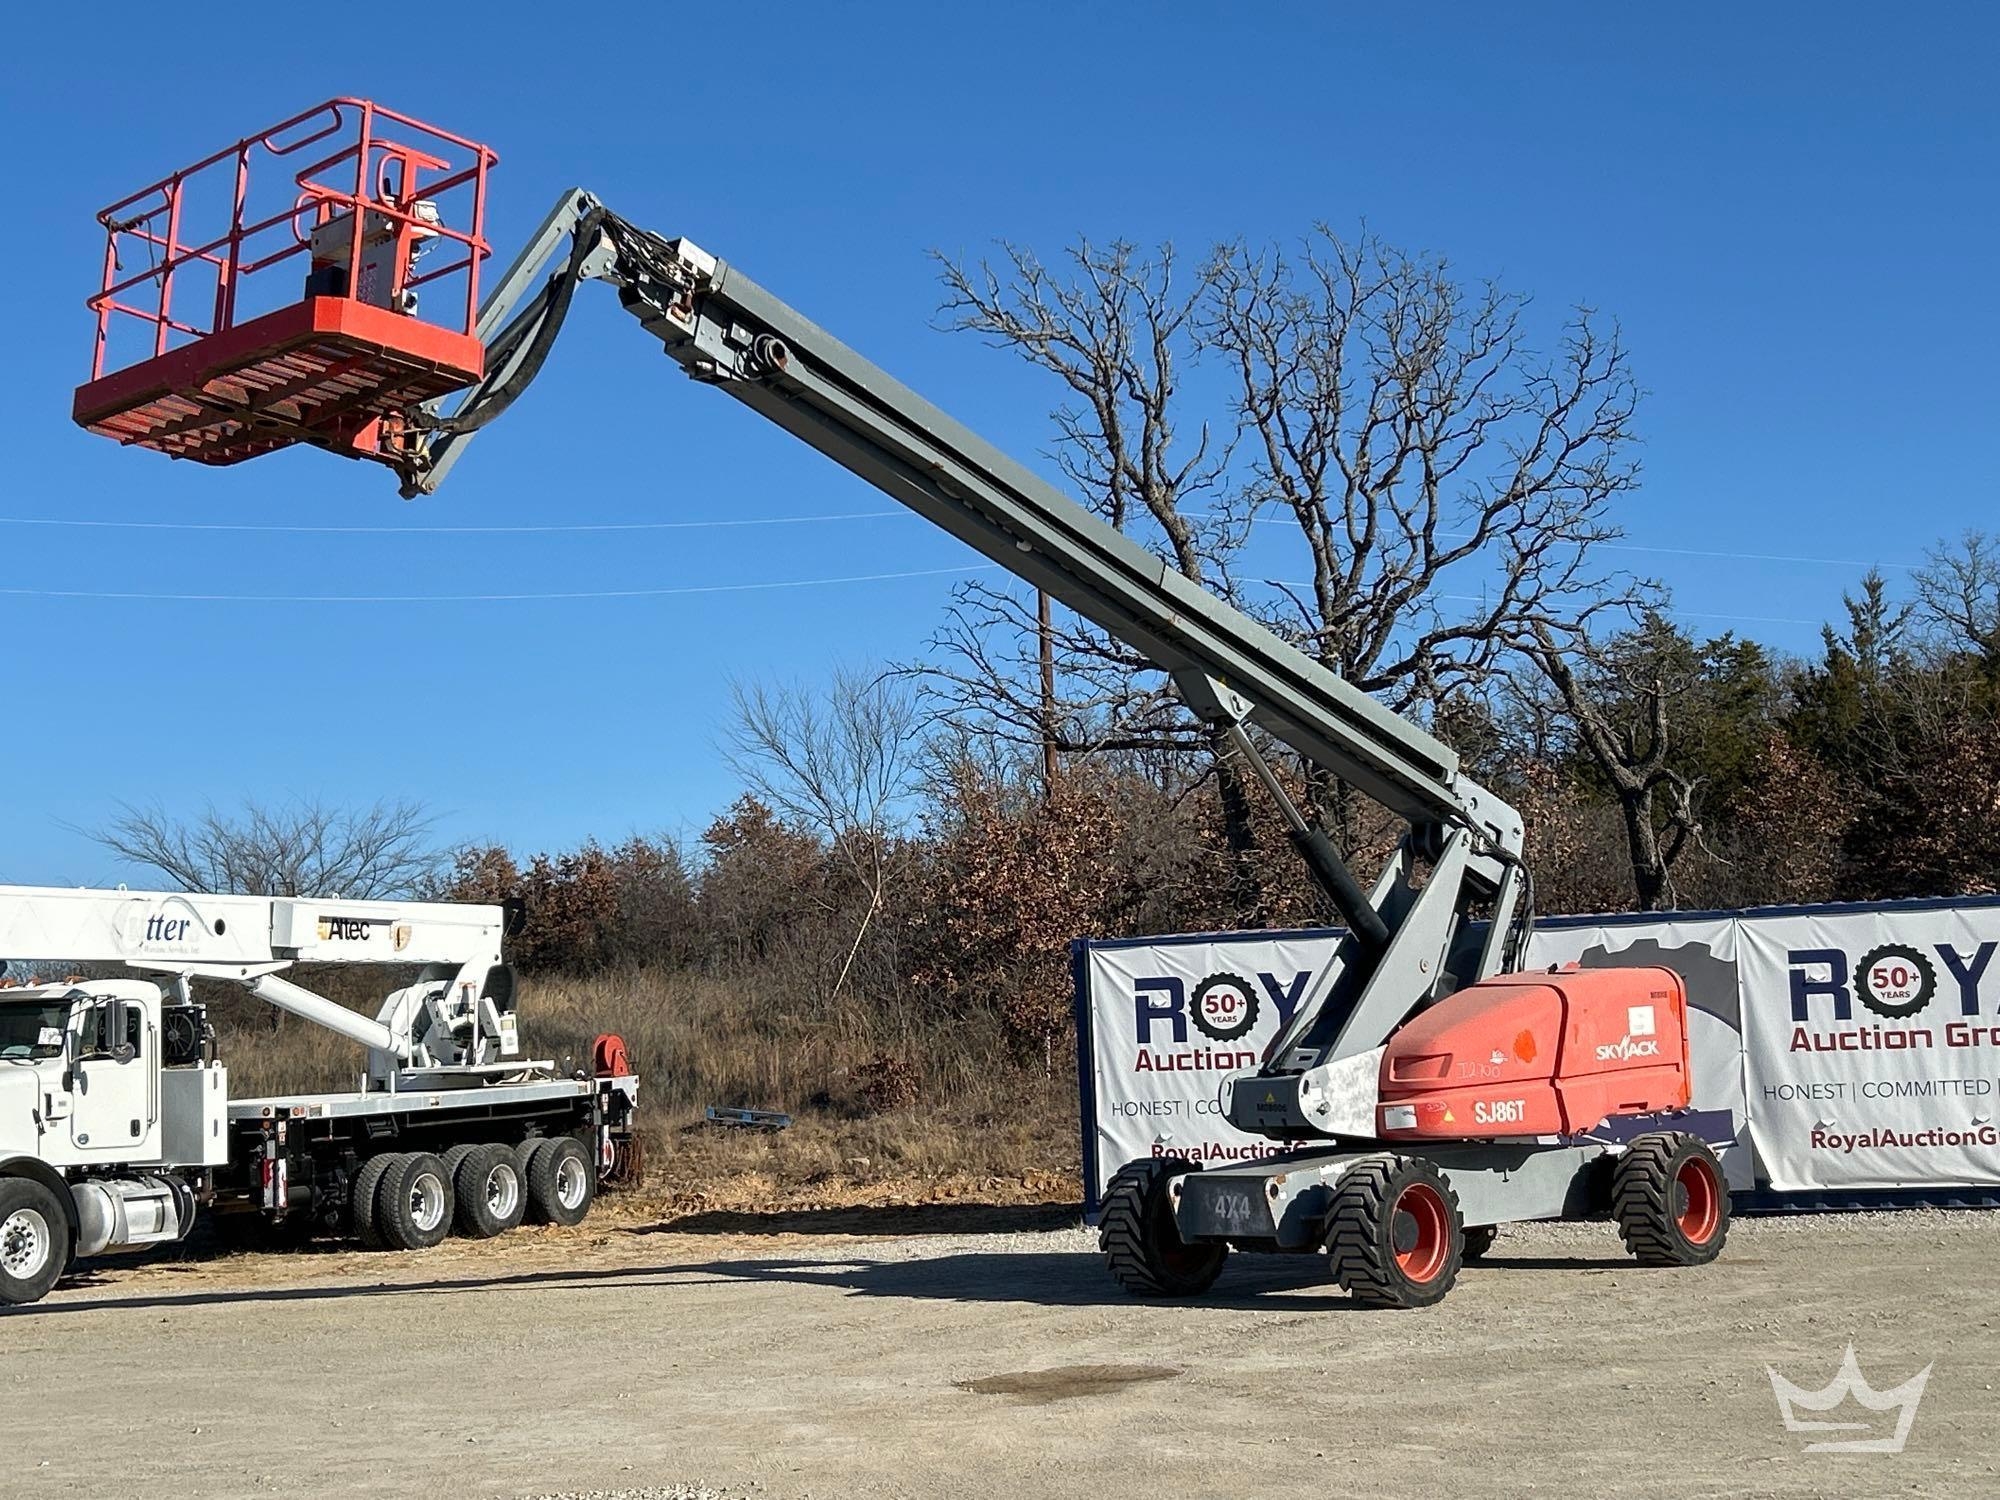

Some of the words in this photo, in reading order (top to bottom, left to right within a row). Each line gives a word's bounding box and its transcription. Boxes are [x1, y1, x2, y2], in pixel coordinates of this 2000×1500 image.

[1872, 966, 1920, 989] 50+
[1204, 993, 1246, 1014] 50+
[1880, 990, 1911, 999] YEARS
[1211, 1015, 1238, 1024] YEARS
[1596, 1034, 1660, 1062] SKYJACK
[1789, 1023, 1933, 1052] Auction
[1134, 1046, 1256, 1072] Auction
[1763, 1083, 1846, 1101] HONEST
[1862, 1079, 1991, 1098] COMMITTED
[1112, 1100, 1182, 1117] HONEST
[1195, 1099, 1220, 1115] CO
[1475, 1100, 1526, 1124] SJ86T
[1811, 1126, 2000, 1154] RoyalAuctionG
